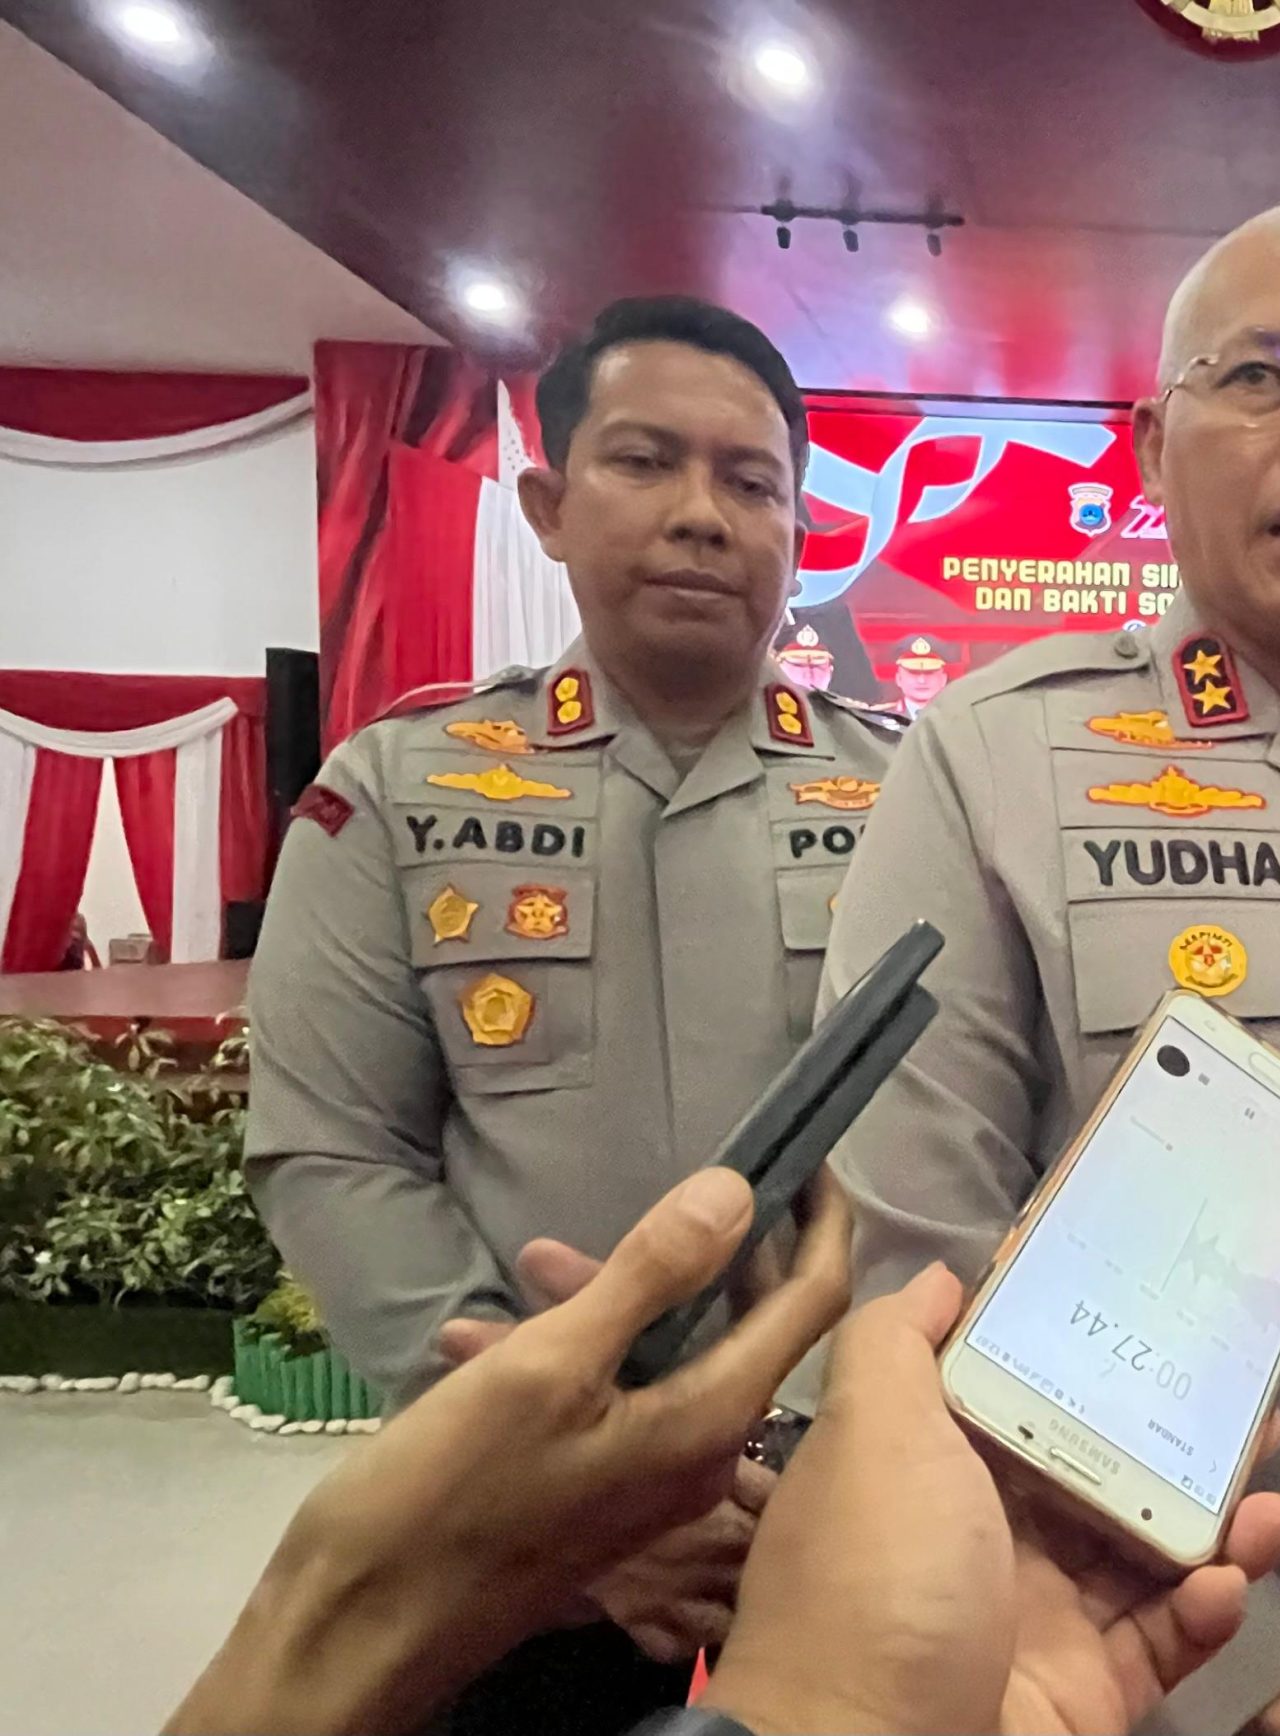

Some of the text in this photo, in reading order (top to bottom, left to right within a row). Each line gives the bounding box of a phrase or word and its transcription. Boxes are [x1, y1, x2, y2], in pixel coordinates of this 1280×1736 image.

[943, 556, 1131, 588] PENYERAHAN
[975, 586, 1031, 612] DAN
[1043, 588, 1127, 614] BAKTI
[406, 814, 586, 858] Y.ABDI
[789, 823, 866, 859] PO
[1049, 1418, 1121, 1476] SAMSUNG
[1147, 1418, 1195, 1457] STANDAR
